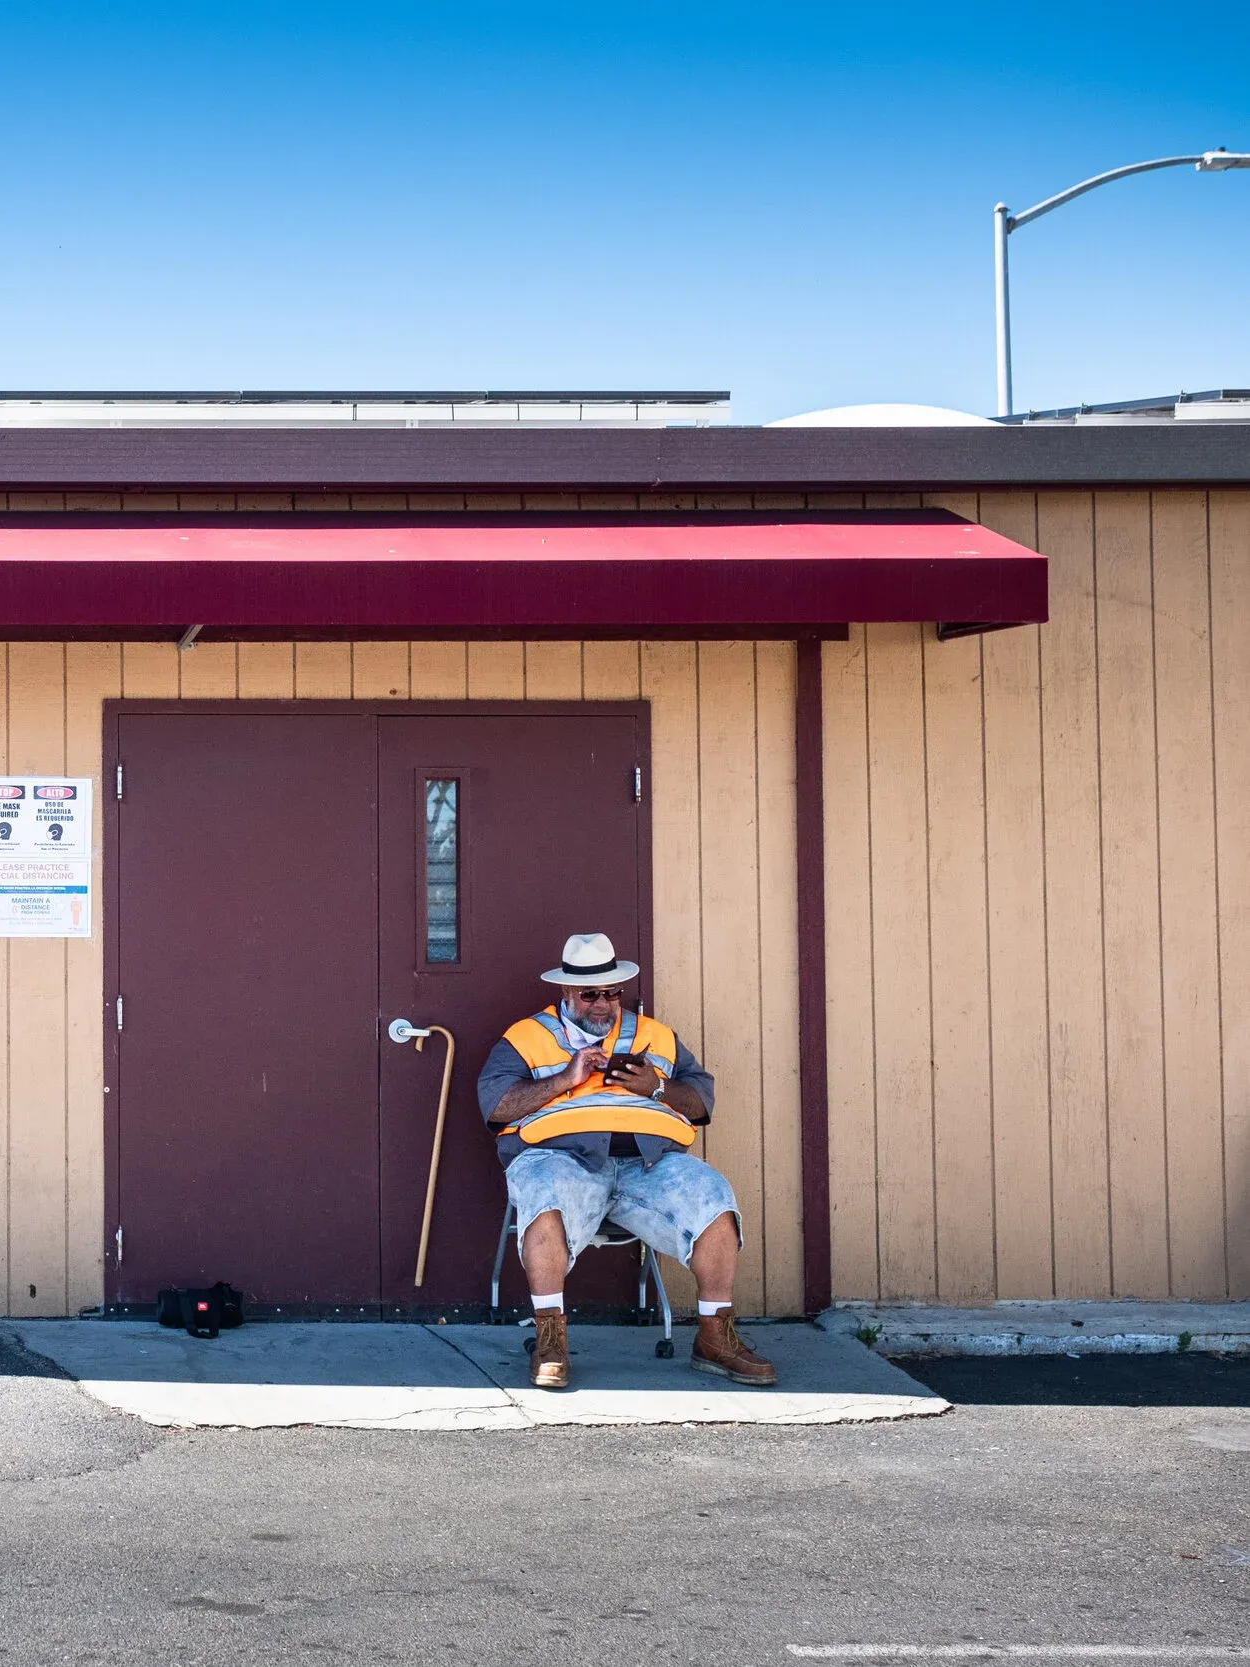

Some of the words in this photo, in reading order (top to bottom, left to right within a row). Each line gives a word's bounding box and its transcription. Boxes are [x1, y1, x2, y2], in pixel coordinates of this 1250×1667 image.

[45, 789, 65, 798] ALTO
[27, 863, 70, 871] PRACTICE
[22, 872, 74, 880] DISTANCING
